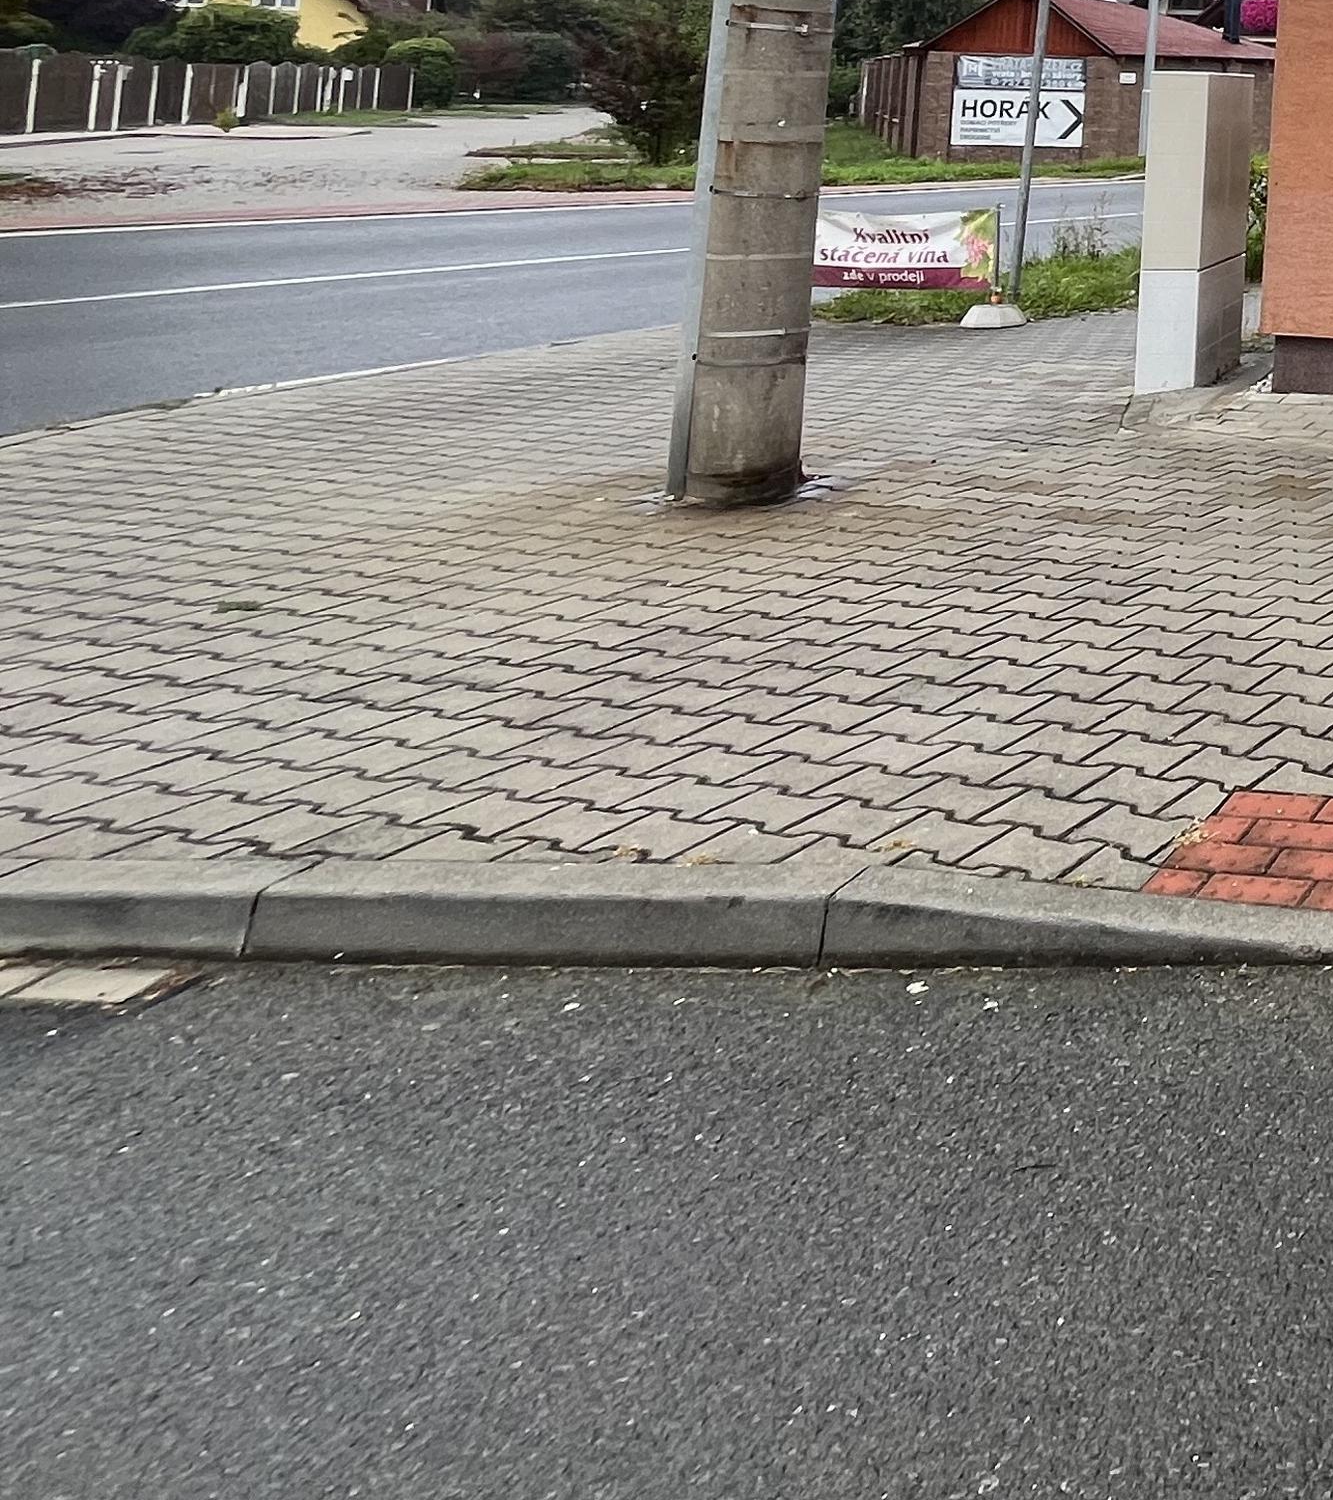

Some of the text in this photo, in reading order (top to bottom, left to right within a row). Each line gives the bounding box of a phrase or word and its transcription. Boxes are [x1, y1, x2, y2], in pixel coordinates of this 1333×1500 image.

[852, 227, 930, 245] Kvalitní
[820, 246, 949, 264] stáčená vína
[843, 270, 925, 284] zde v prodeji
